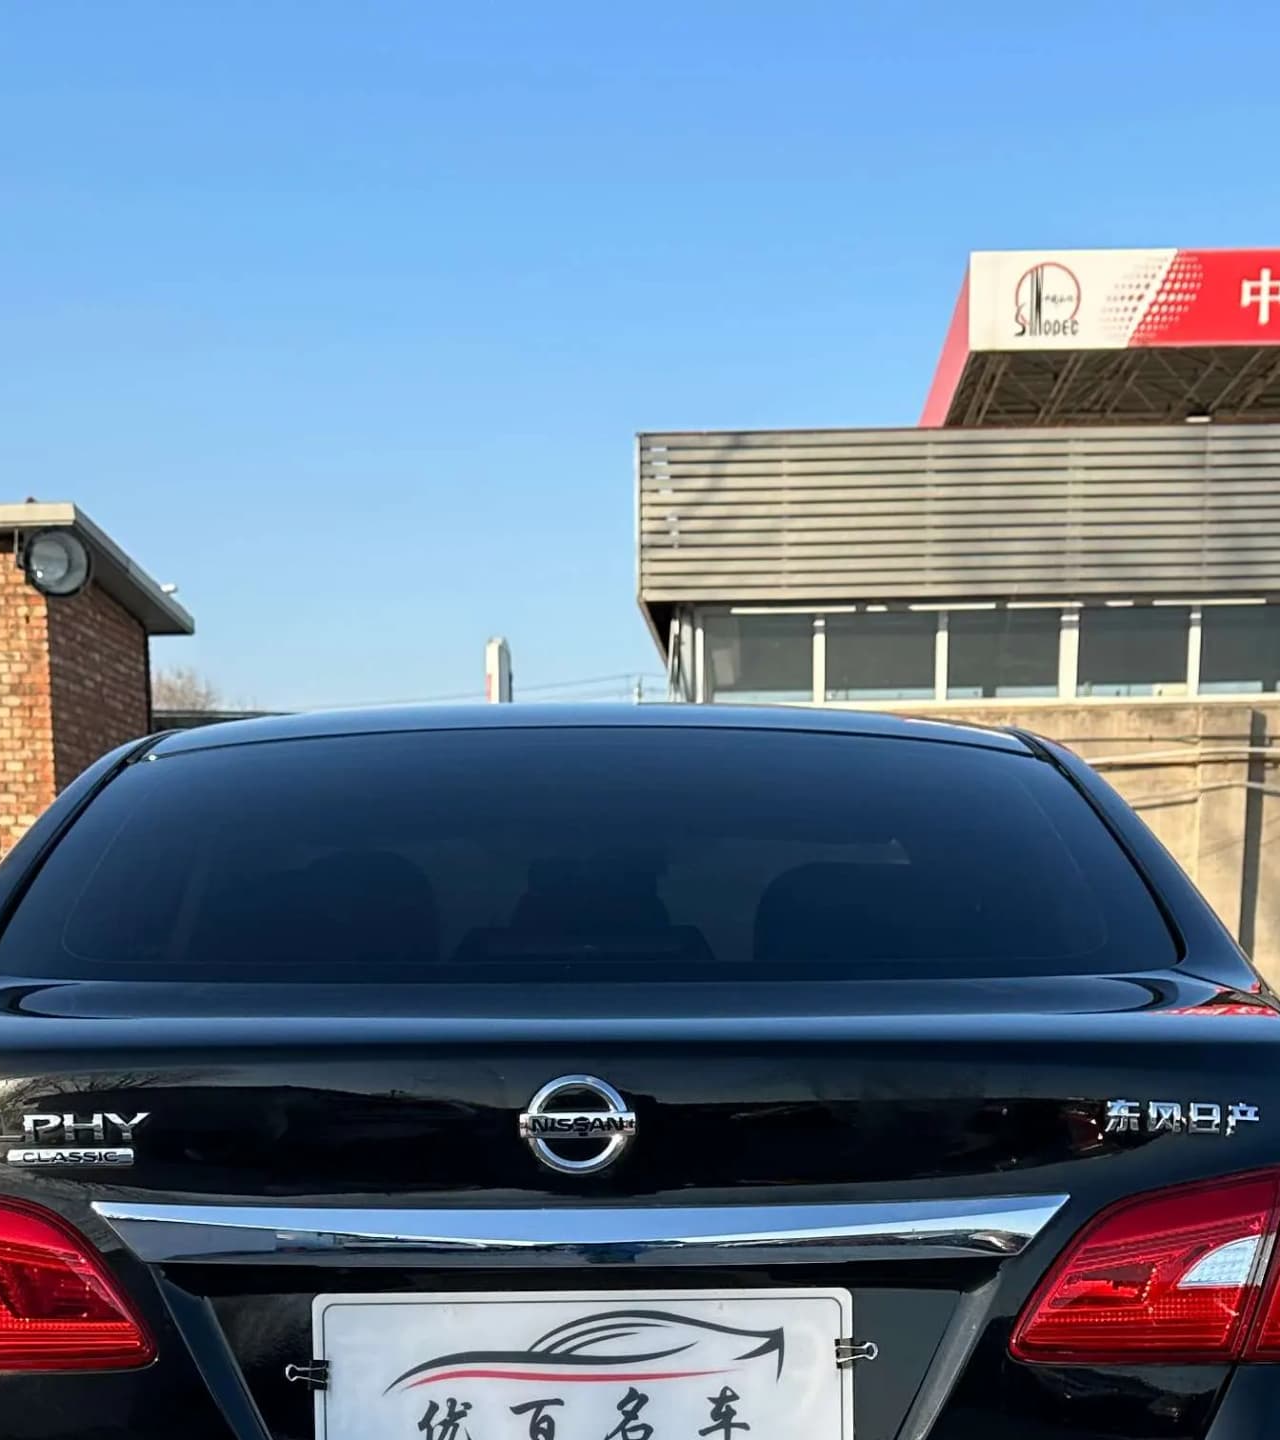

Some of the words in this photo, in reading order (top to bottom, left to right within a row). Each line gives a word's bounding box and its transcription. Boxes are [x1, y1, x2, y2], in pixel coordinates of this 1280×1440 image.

[531, 1116, 625, 1134] NISSAN
[1104, 1099, 1260, 1137] 东风日产
[22, 1150, 120, 1163] CLASSIC
